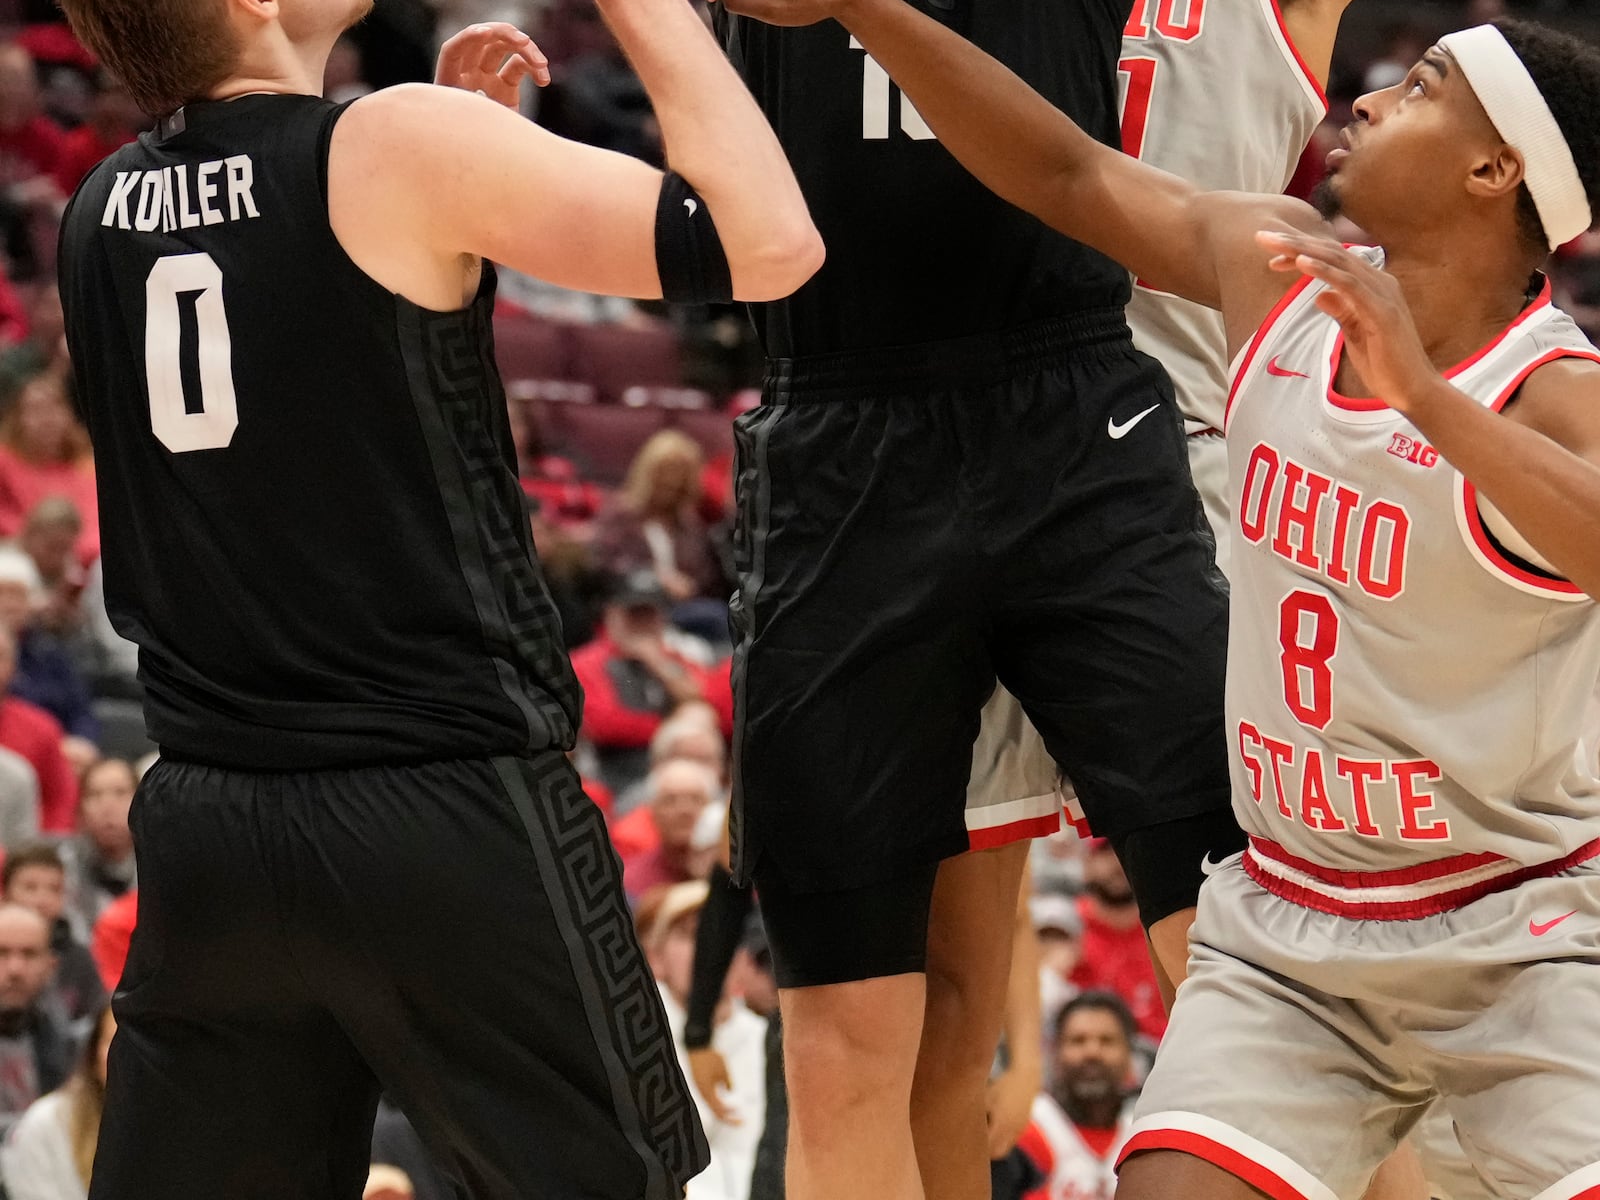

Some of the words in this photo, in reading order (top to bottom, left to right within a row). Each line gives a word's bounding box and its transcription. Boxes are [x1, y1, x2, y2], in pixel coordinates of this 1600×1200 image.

[848, 34, 937, 140] 1
[1117, 56, 1158, 161] 1
[101, 154, 260, 233] KOHLER
[145, 252, 239, 453] 0
[1239, 439, 1412, 602] OHIO
[1278, 587, 1340, 732] 8
[1238, 718, 1452, 843] STATE
